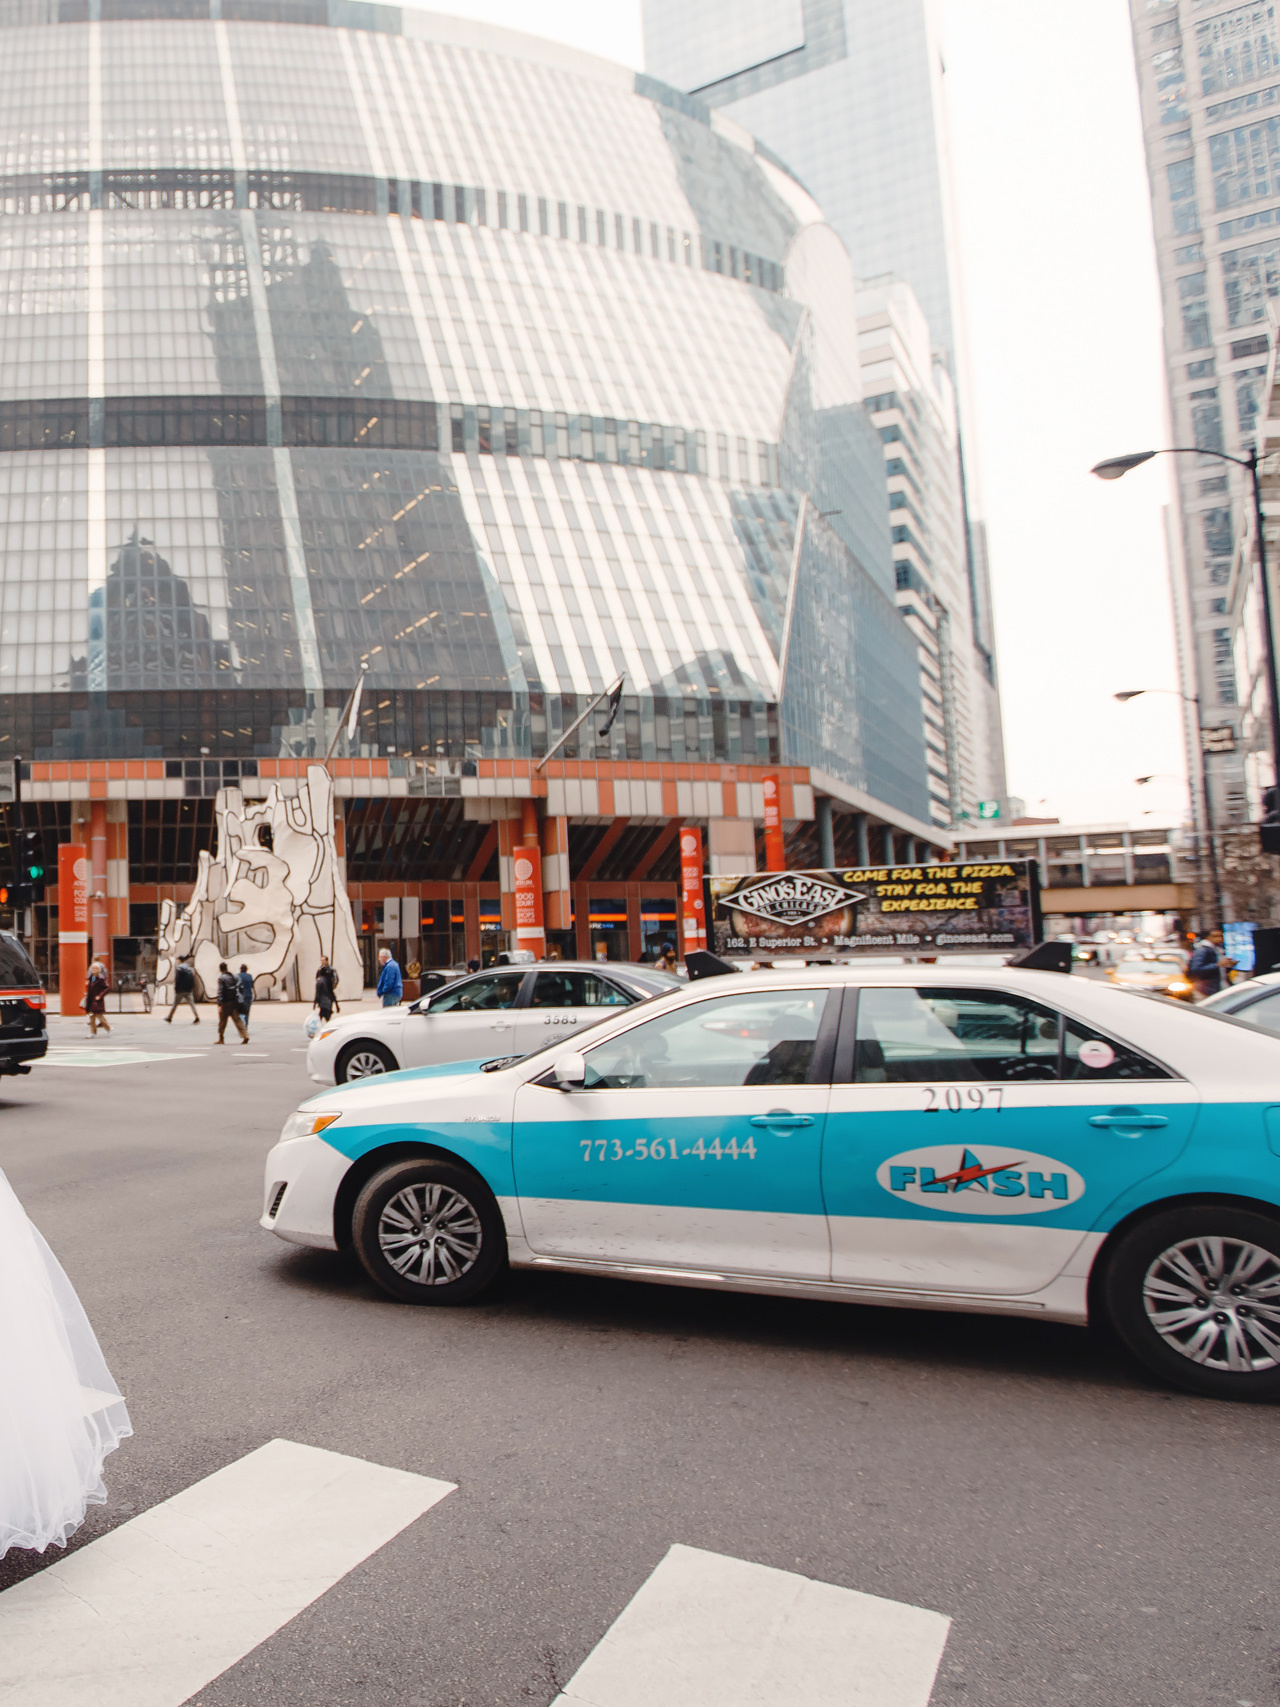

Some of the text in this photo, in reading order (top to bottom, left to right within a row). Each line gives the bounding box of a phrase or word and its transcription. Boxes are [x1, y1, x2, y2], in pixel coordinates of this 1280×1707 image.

[843, 864, 1016, 882] COME FOR THE PIZZA.
[738, 881, 795, 910] GINO'S
[876, 881, 983, 897] STAY FOR THE
[774, 901, 824, 912] CHICAGO
[881, 897, 979, 912] EXPERIENCE.
[726, 933, 1016, 949] 162. E Superior St. Magnificent Mile ginoseast.com
[544, 1015, 577, 1025] 3583
[922, 1087, 1004, 1113] 2097
[579, 1136, 758, 1162] 773-561-4444
[889, 1148, 1069, 1200] FLASH
